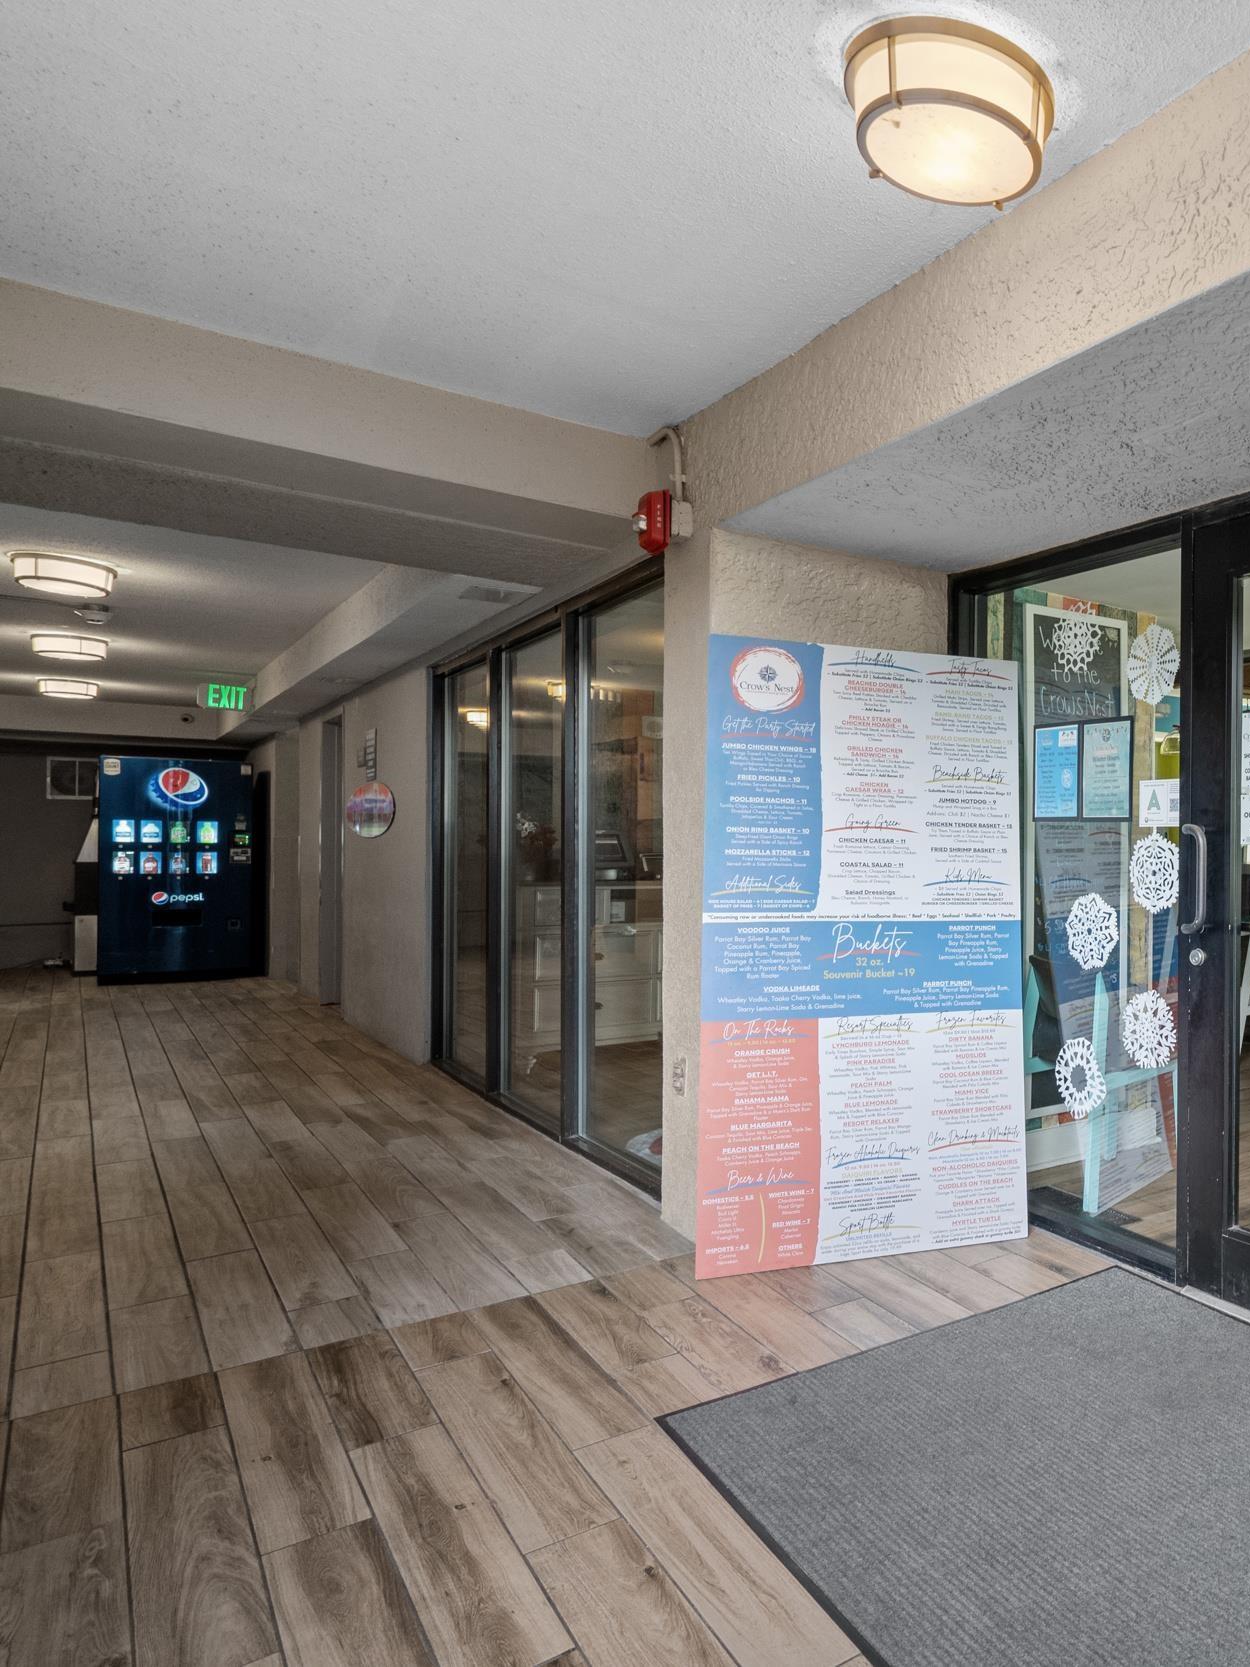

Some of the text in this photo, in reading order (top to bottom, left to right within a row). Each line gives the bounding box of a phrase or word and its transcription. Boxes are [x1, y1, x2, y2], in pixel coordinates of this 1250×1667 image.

[740, 681, 794, 693] Crow's Nest
[844, 685, 893, 694] CHEESEBURGER
[208, 684, 247, 710] EXIT
[1085, 689, 1115, 717] Nest
[848, 714, 870, 722] PHILLY
[756, 716, 784, 737] Party
[730, 795, 795, 804] POOLSIDE NACHOS
[1147, 788, 1161, 811] A
[724, 848, 771, 856] MOZZARELLA
[774, 875, 802, 893] Sides
[170, 892, 204, 903] pepsi
[832, 922, 913, 963] Buckets
[856, 957, 884, 966] 32 oz.
[823, 968, 894, 979] Souvenir Bucket
[723, 1018, 794, 1040] On The Rocks
[832, 1039, 910, 1049] LYNCHBURG LEMONADE
[766, 1095, 789, 1103] MAMA
[750, 1120, 792, 1129] MARGARITA
[775, 1142, 799, 1150] BEACH
[727, 1170, 753, 1190] Beer
[766, 1167, 794, 1185] Wine
[938, 1181, 967, 1190] CUDDLES
[980, 1178, 992, 1186] THE
[992, 1177, 1013, 1185] BEACH
